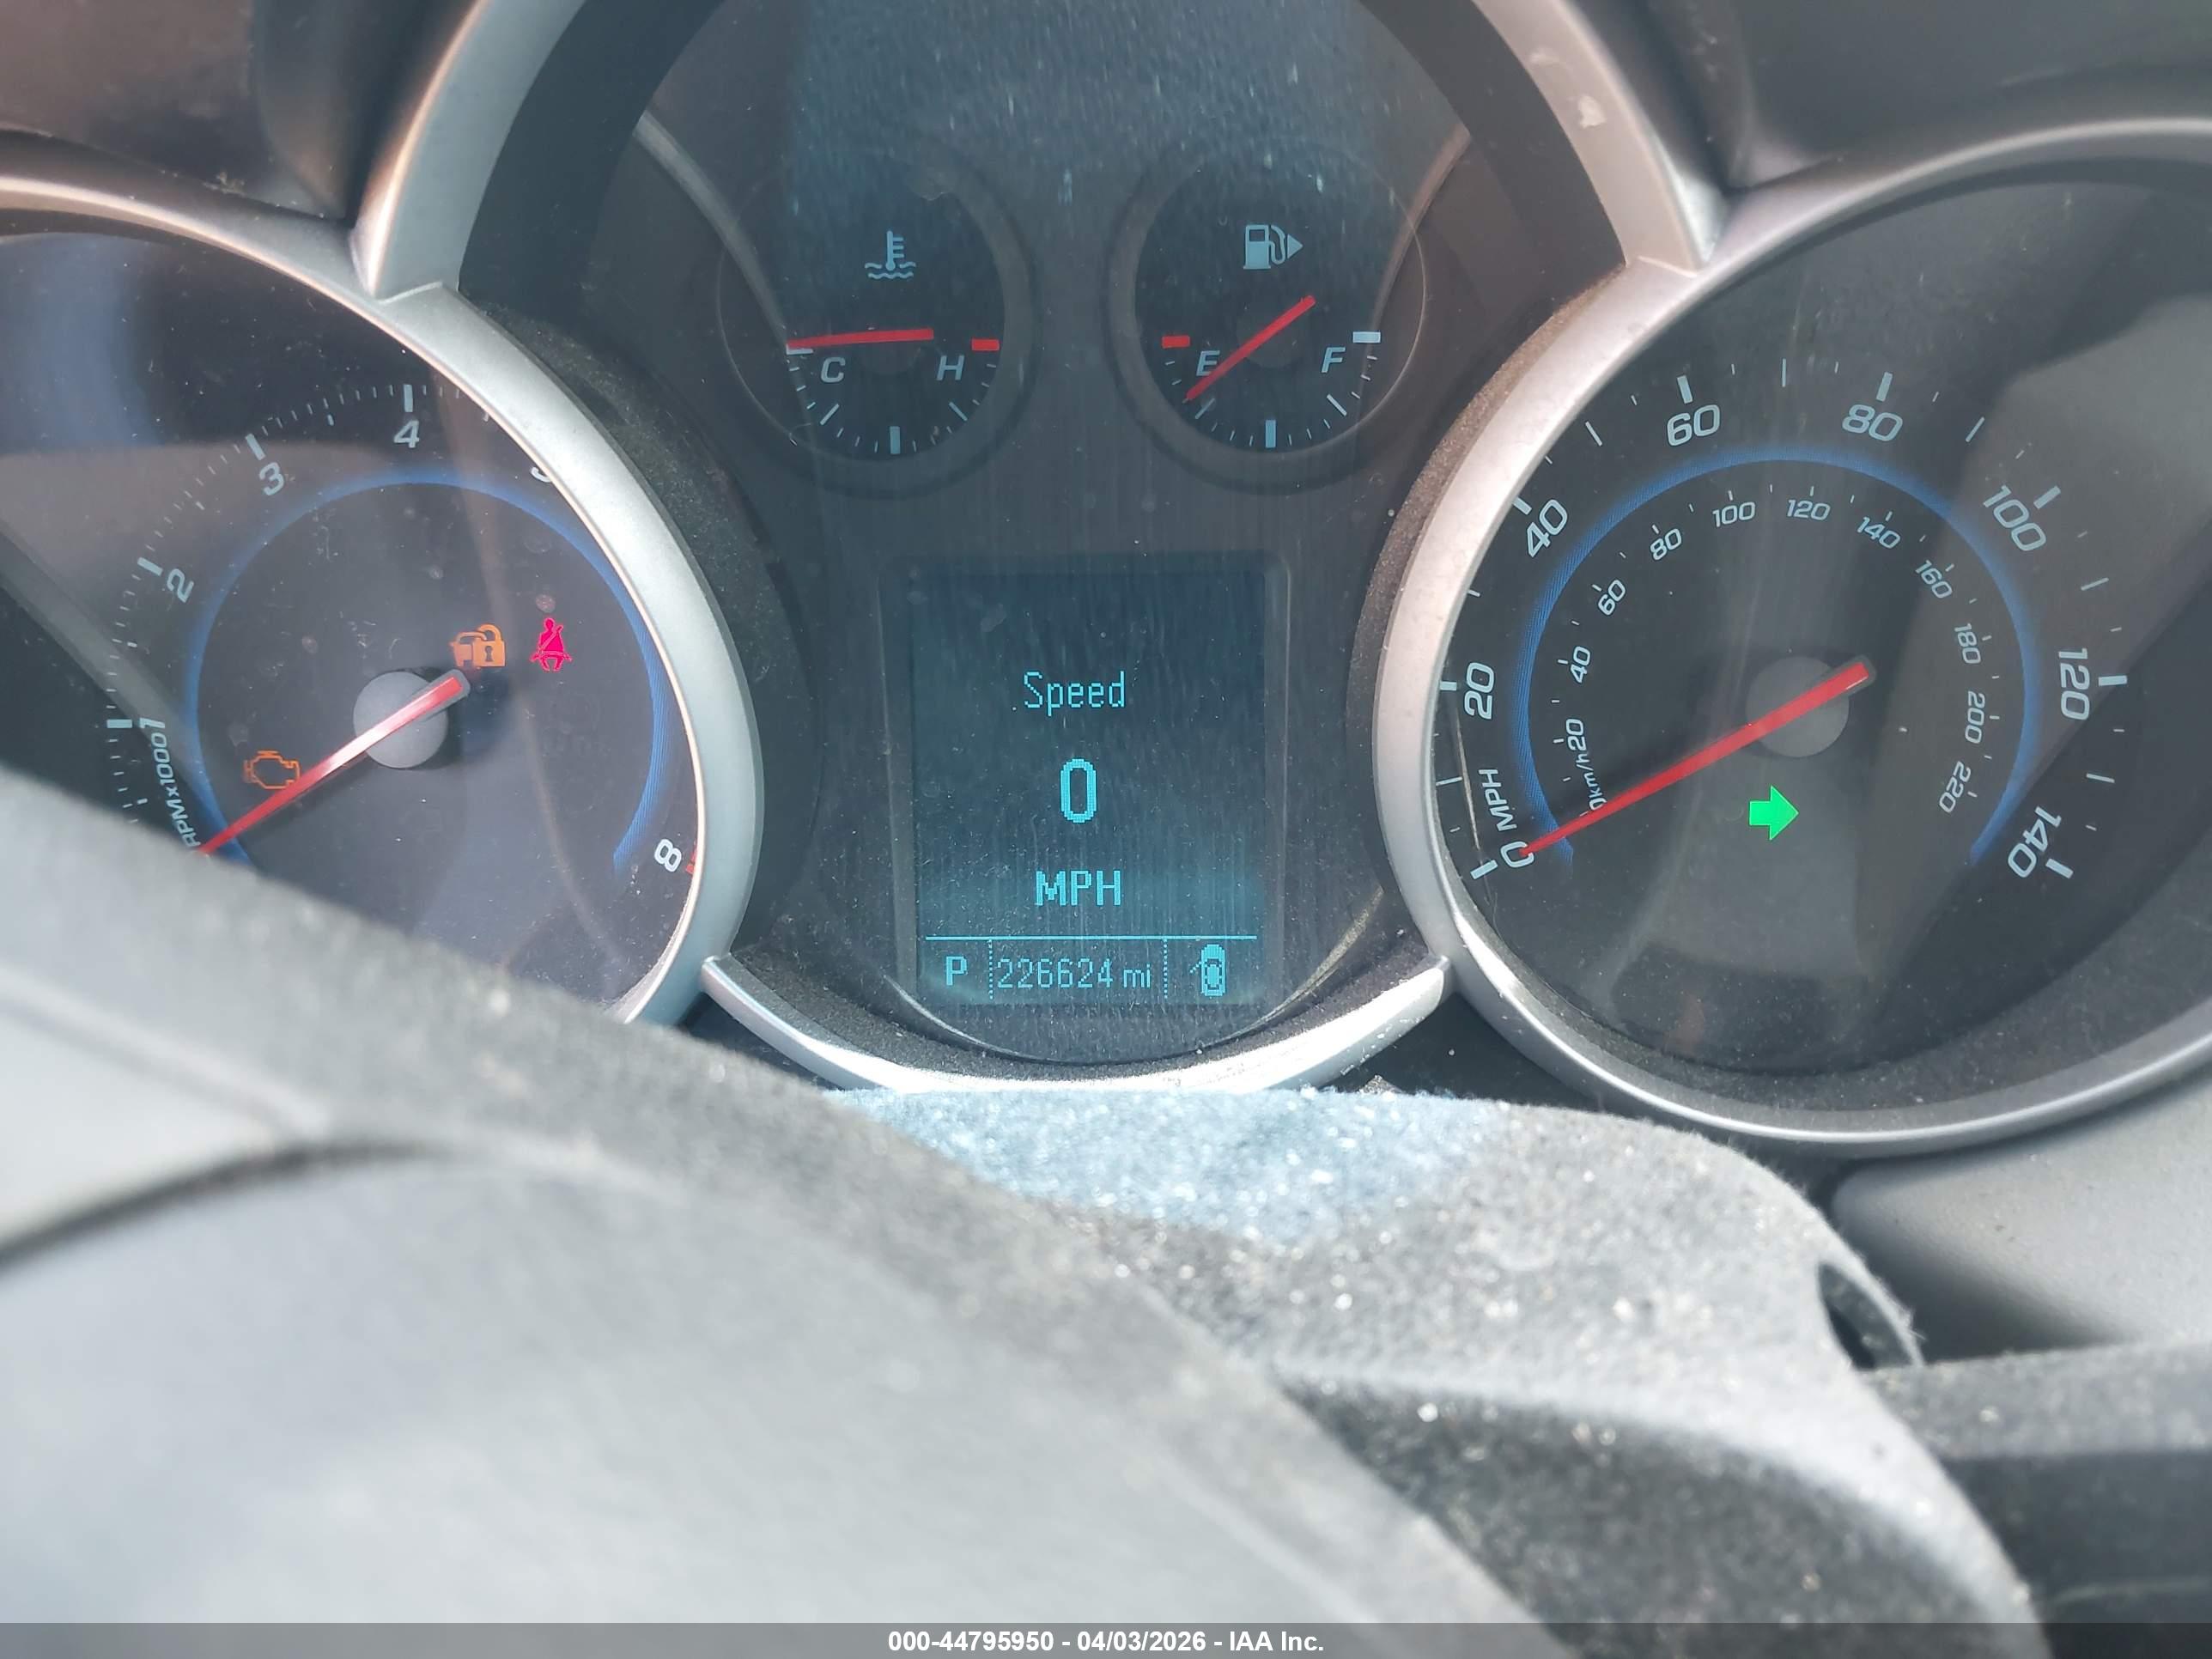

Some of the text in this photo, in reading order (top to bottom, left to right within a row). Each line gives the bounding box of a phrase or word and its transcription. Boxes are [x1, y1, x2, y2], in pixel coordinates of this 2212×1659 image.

[820, 356, 846, 384] C
[937, 355, 965, 381] H
[1195, 350, 1220, 376] E
[1322, 347, 1346, 374] F
[393, 421, 420, 448] 4
[1666, 404, 1721, 447] 60
[1841, 404, 1903, 441] 80
[259, 462, 285, 495] 3
[1524, 498, 1569, 557] 40
[1712, 501, 1756, 527] 100
[1786, 499, 1831, 521] 120
[1982, 484, 2047, 552] 100
[1650, 528, 1683, 561] 80
[1856, 517, 1900, 549] 140
[166, 568, 196, 604] 2
[1598, 579, 1627, 615] 60
[1915, 560, 1953, 599] 160
[1954, 623, 1982, 665] 180
[1571, 646, 1591, 684] 40
[1024, 671, 1126, 717] Speed
[1464, 662, 1495, 720] 20
[2057, 647, 2090, 720] 120
[139, 717, 166, 729] 1
[1565, 718, 1588, 751] 20
[1964, 690, 1986, 744] 200
[1059, 758, 1097, 823] 0
[1938, 761, 1972, 814] 220
[1478, 769, 1534, 868] 0 MPH
[654, 838, 682, 872] 8
[2007, 805, 2062, 878] 140
[1035, 870, 1121, 906] MPH
[945, 955, 1151, 988] P 226624 mi
